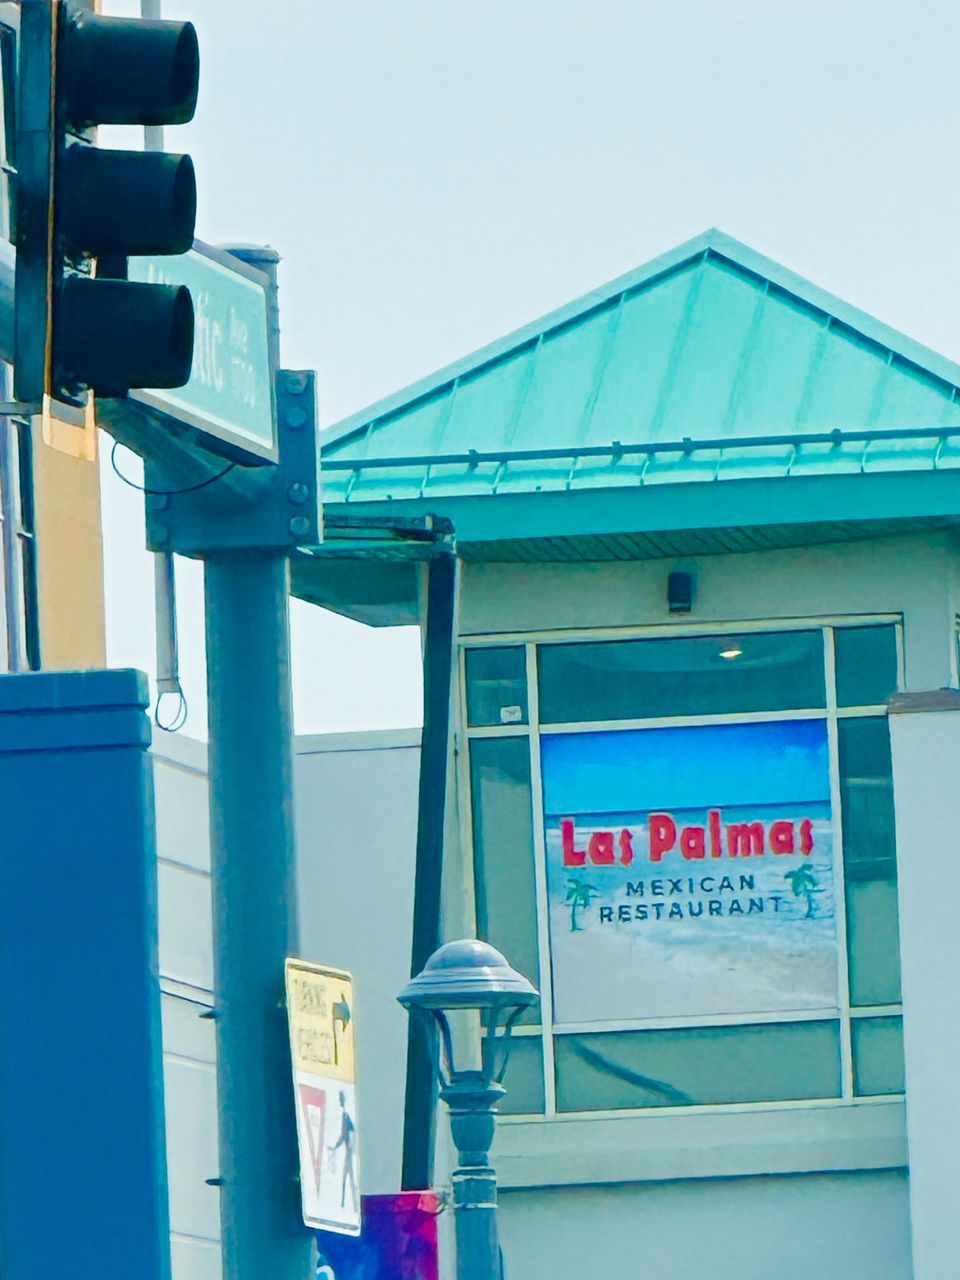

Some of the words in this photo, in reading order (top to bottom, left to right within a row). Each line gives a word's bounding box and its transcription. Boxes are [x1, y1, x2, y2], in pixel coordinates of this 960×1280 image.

[561, 817, 634, 867] Las
[647, 808, 815, 863] Palmas
[625, 874, 756, 898] MEXICAN
[599, 896, 784, 924] RESTAURANT
